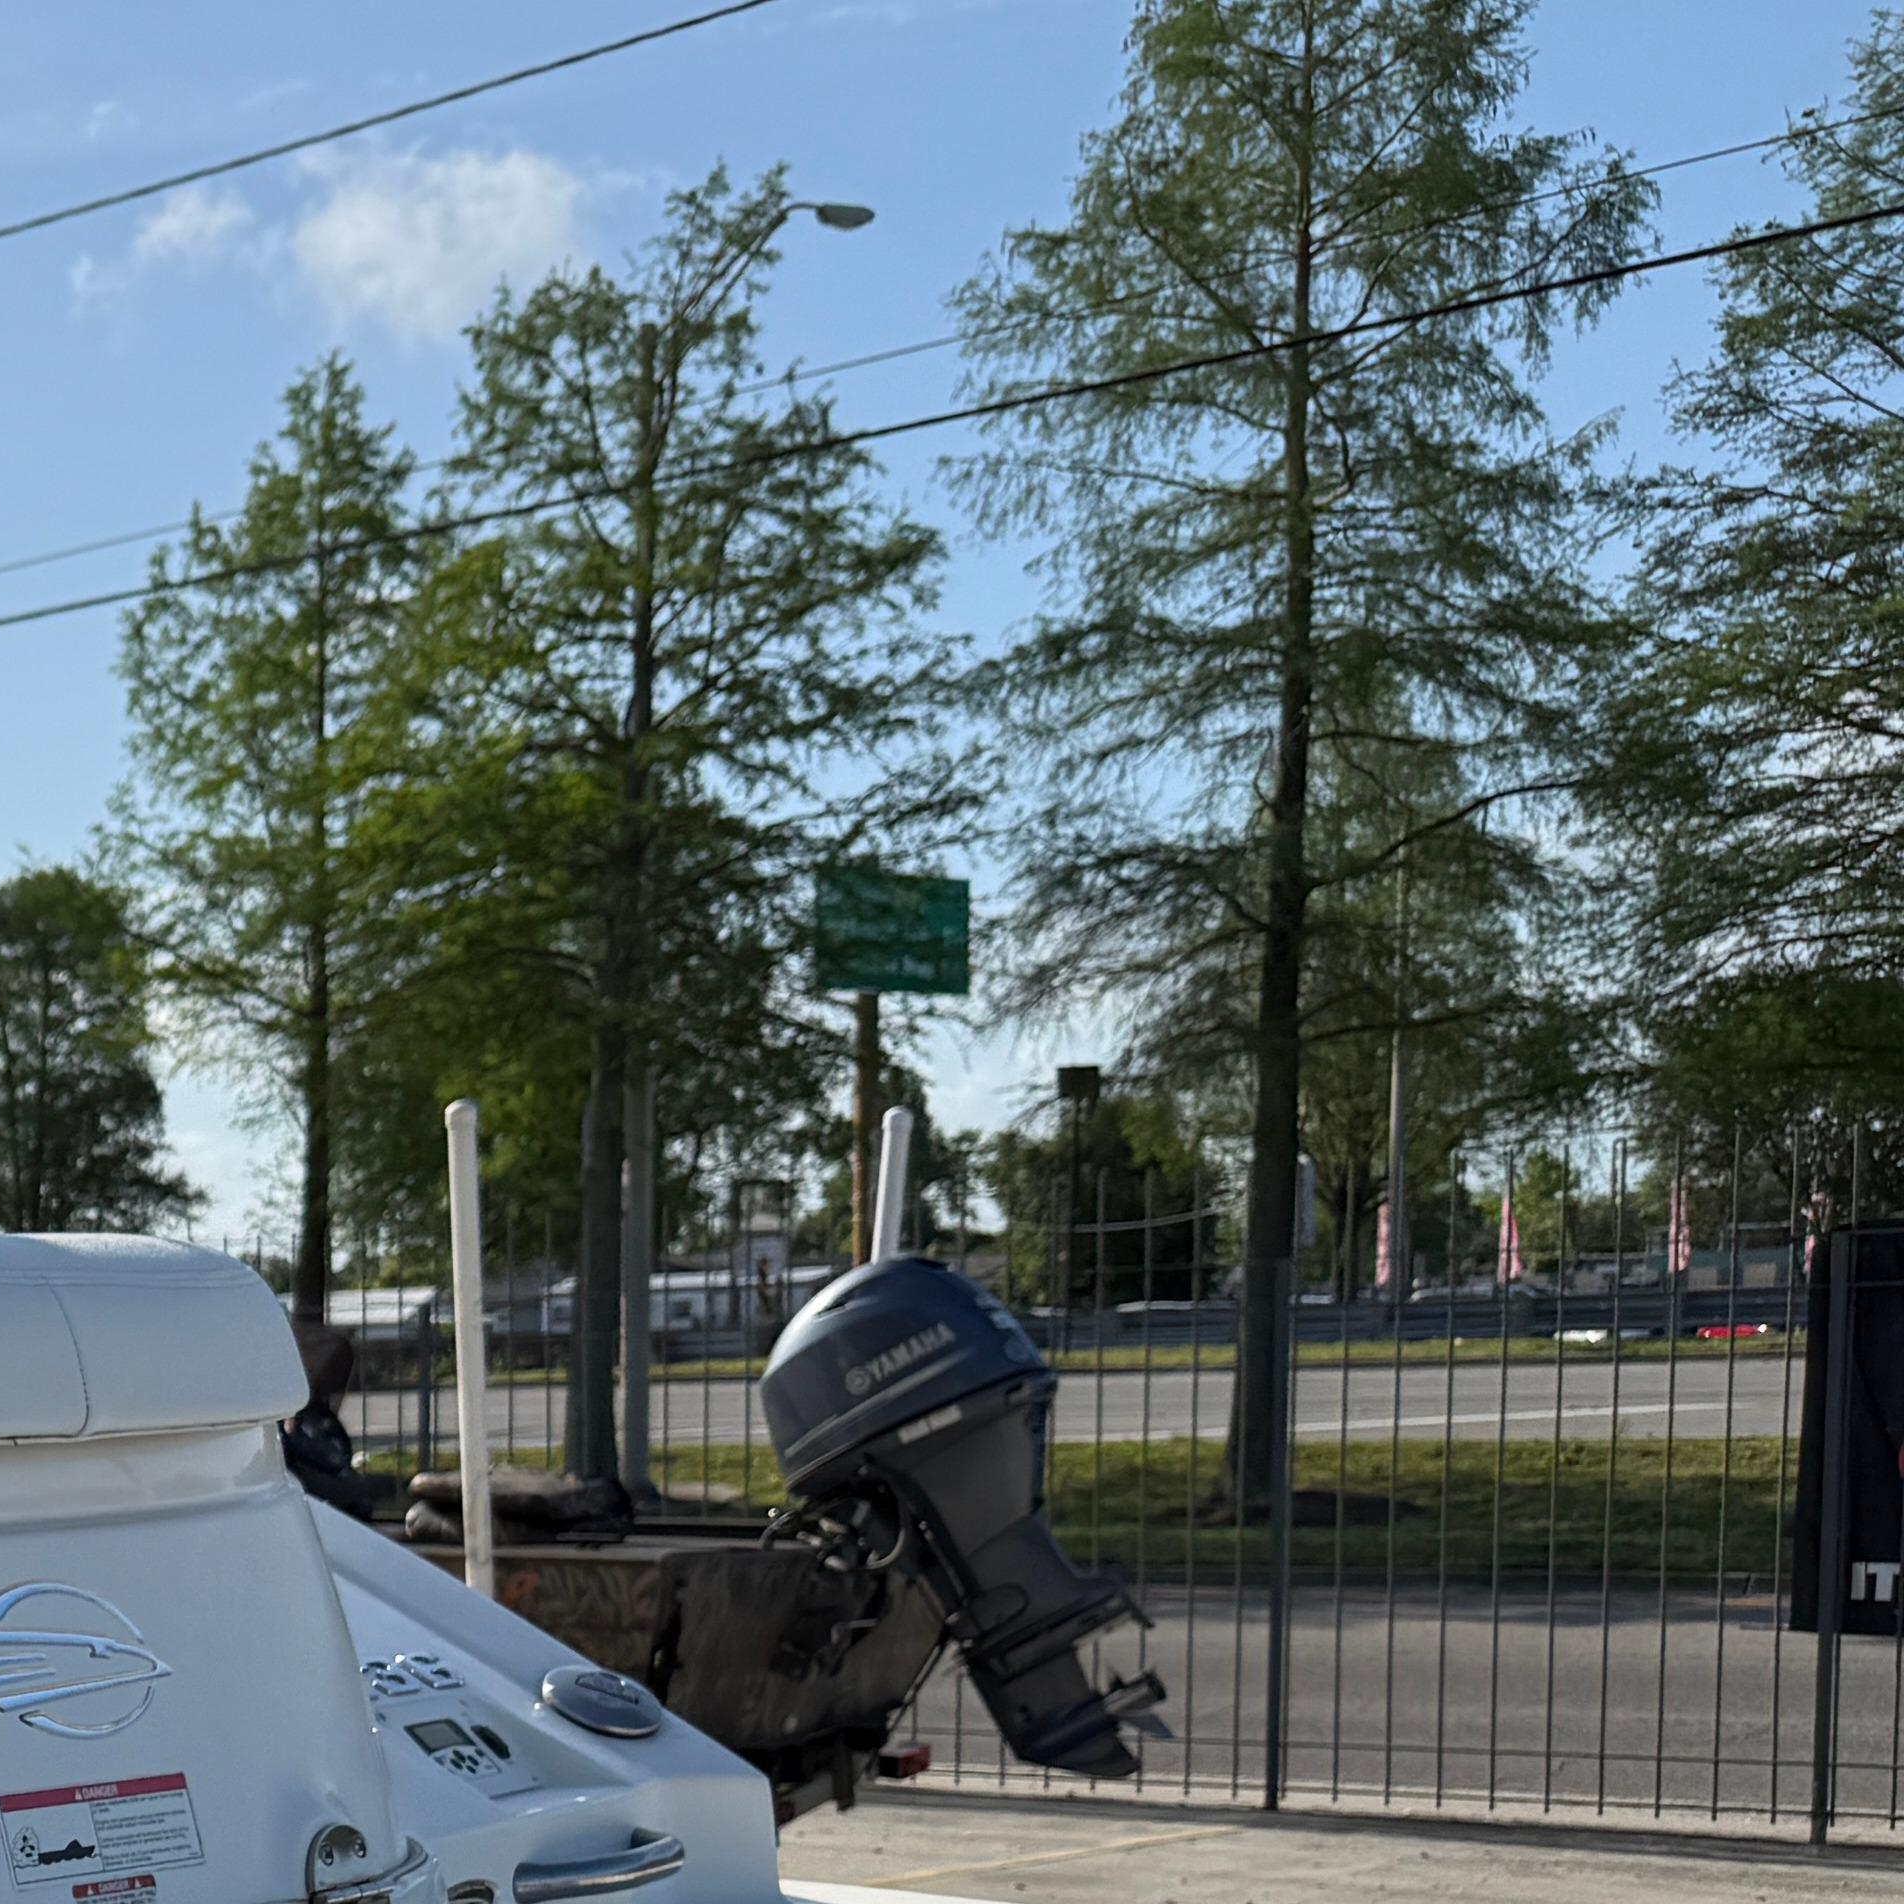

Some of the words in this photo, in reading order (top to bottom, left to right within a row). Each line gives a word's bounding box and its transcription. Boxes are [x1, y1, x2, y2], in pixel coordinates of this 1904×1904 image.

[866, 1320, 956, 1382] YAMAHA
[82, 1784, 118, 1800] DANGER
[99, 1881, 130, 1894] DANGER
